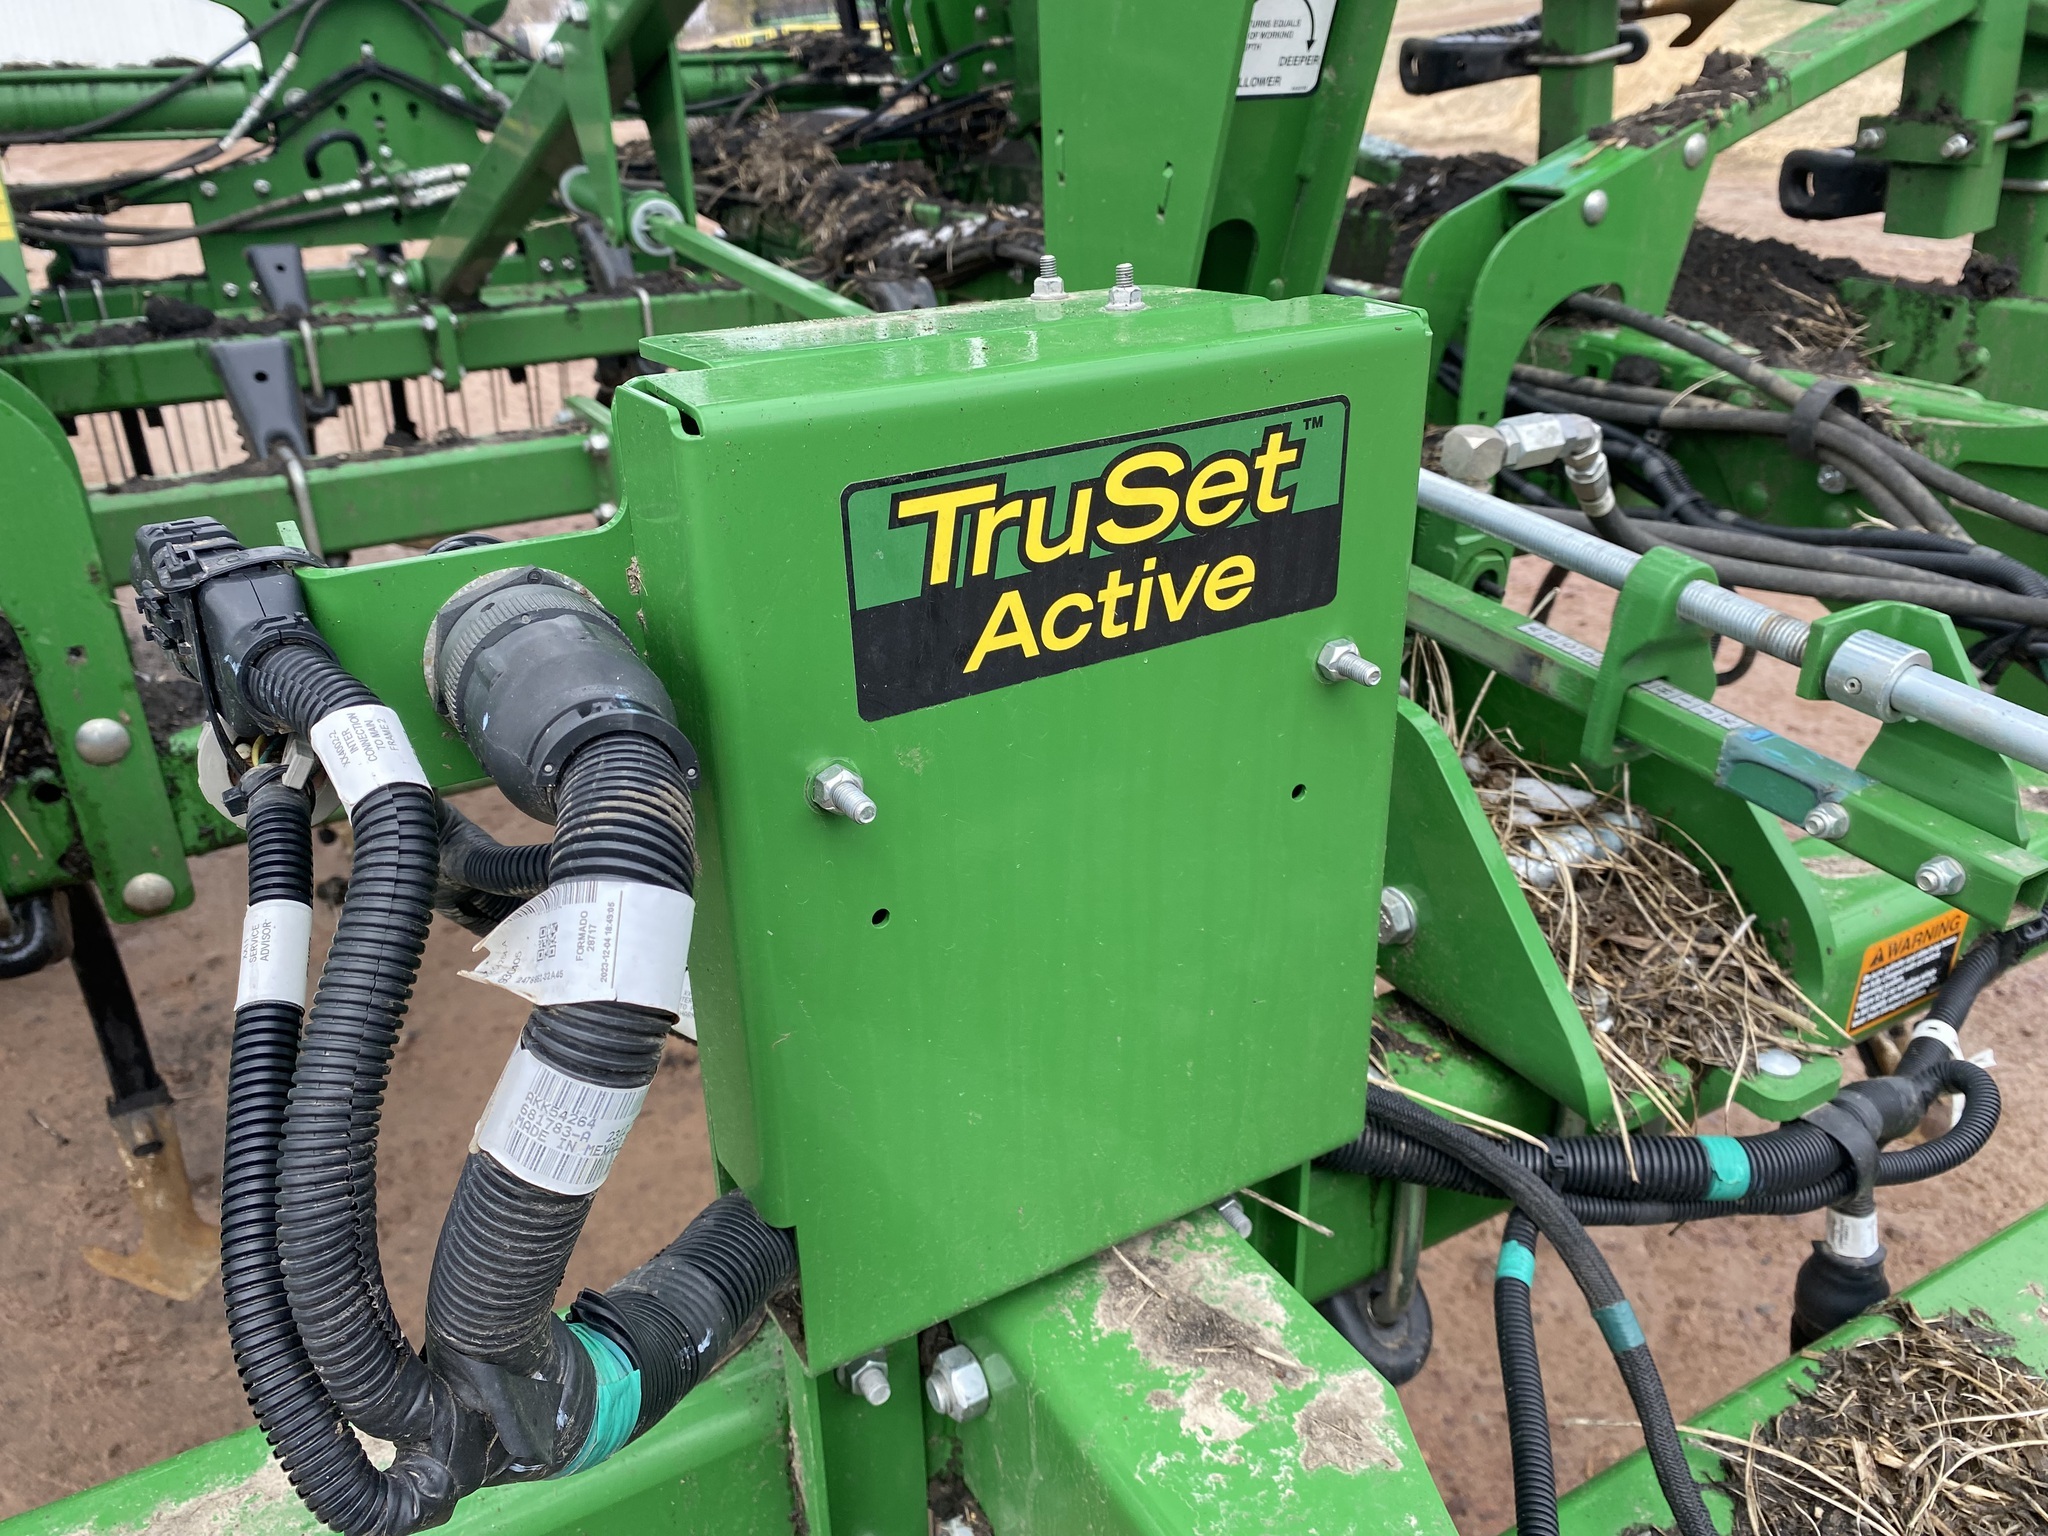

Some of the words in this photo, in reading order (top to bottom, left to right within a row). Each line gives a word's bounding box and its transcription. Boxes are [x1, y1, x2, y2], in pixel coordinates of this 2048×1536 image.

[1278, 55, 1320, 67] DEEPER
[1239, 76, 1282, 88] LLOWER
[897, 431, 1300, 586] TruSet
[963, 555, 1256, 675] Active
[341, 728, 359, 754] INTER
[346, 712, 378, 762] CONNECTION
[364, 719, 380, 739] MAIN
[374, 740, 386, 750] TO
[380, 725, 399, 751] FRAME
[575, 910, 588, 961] FORMADO
[604, 901, 615, 935] 18:49:05
[1888, 915, 1961, 958] WARNING
[249, 924, 260, 963] SERVICE
[586, 923, 597, 952] 28717
[600, 938, 612, 983] 2023-12-04
[519, 1104, 591, 1142] 681783-A
[525, 1091, 597, 1130] AKK54264
[514, 1115, 550, 1143] MADE
[557, 1138, 578, 1153] IN
